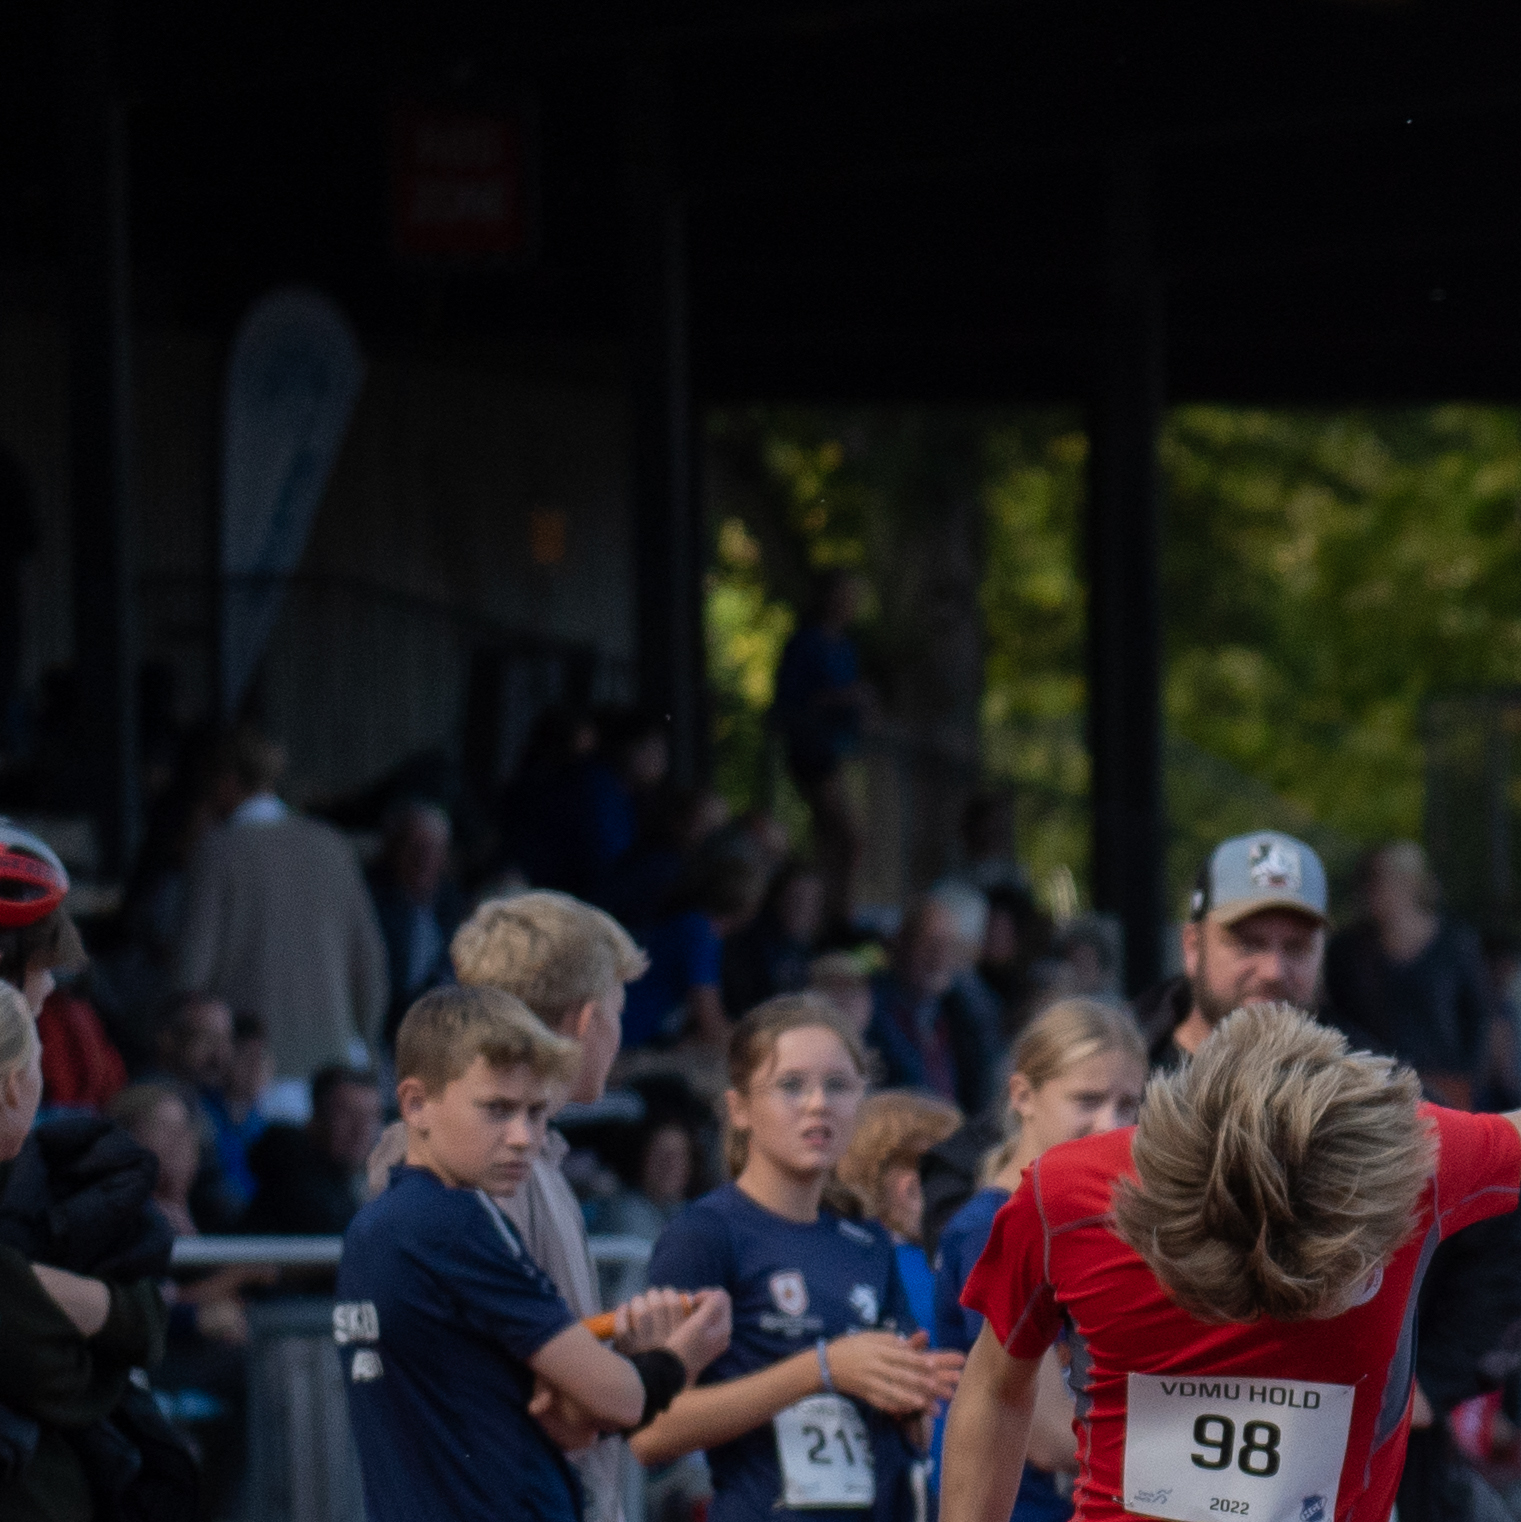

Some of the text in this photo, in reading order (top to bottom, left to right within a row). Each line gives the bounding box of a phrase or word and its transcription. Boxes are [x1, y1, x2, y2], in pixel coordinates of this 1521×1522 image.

[1160, 1382, 1321, 1410] VDMU HOLD
[1190, 1413, 1281, 1478] 98
[1209, 1498, 1250, 1515] 2022
